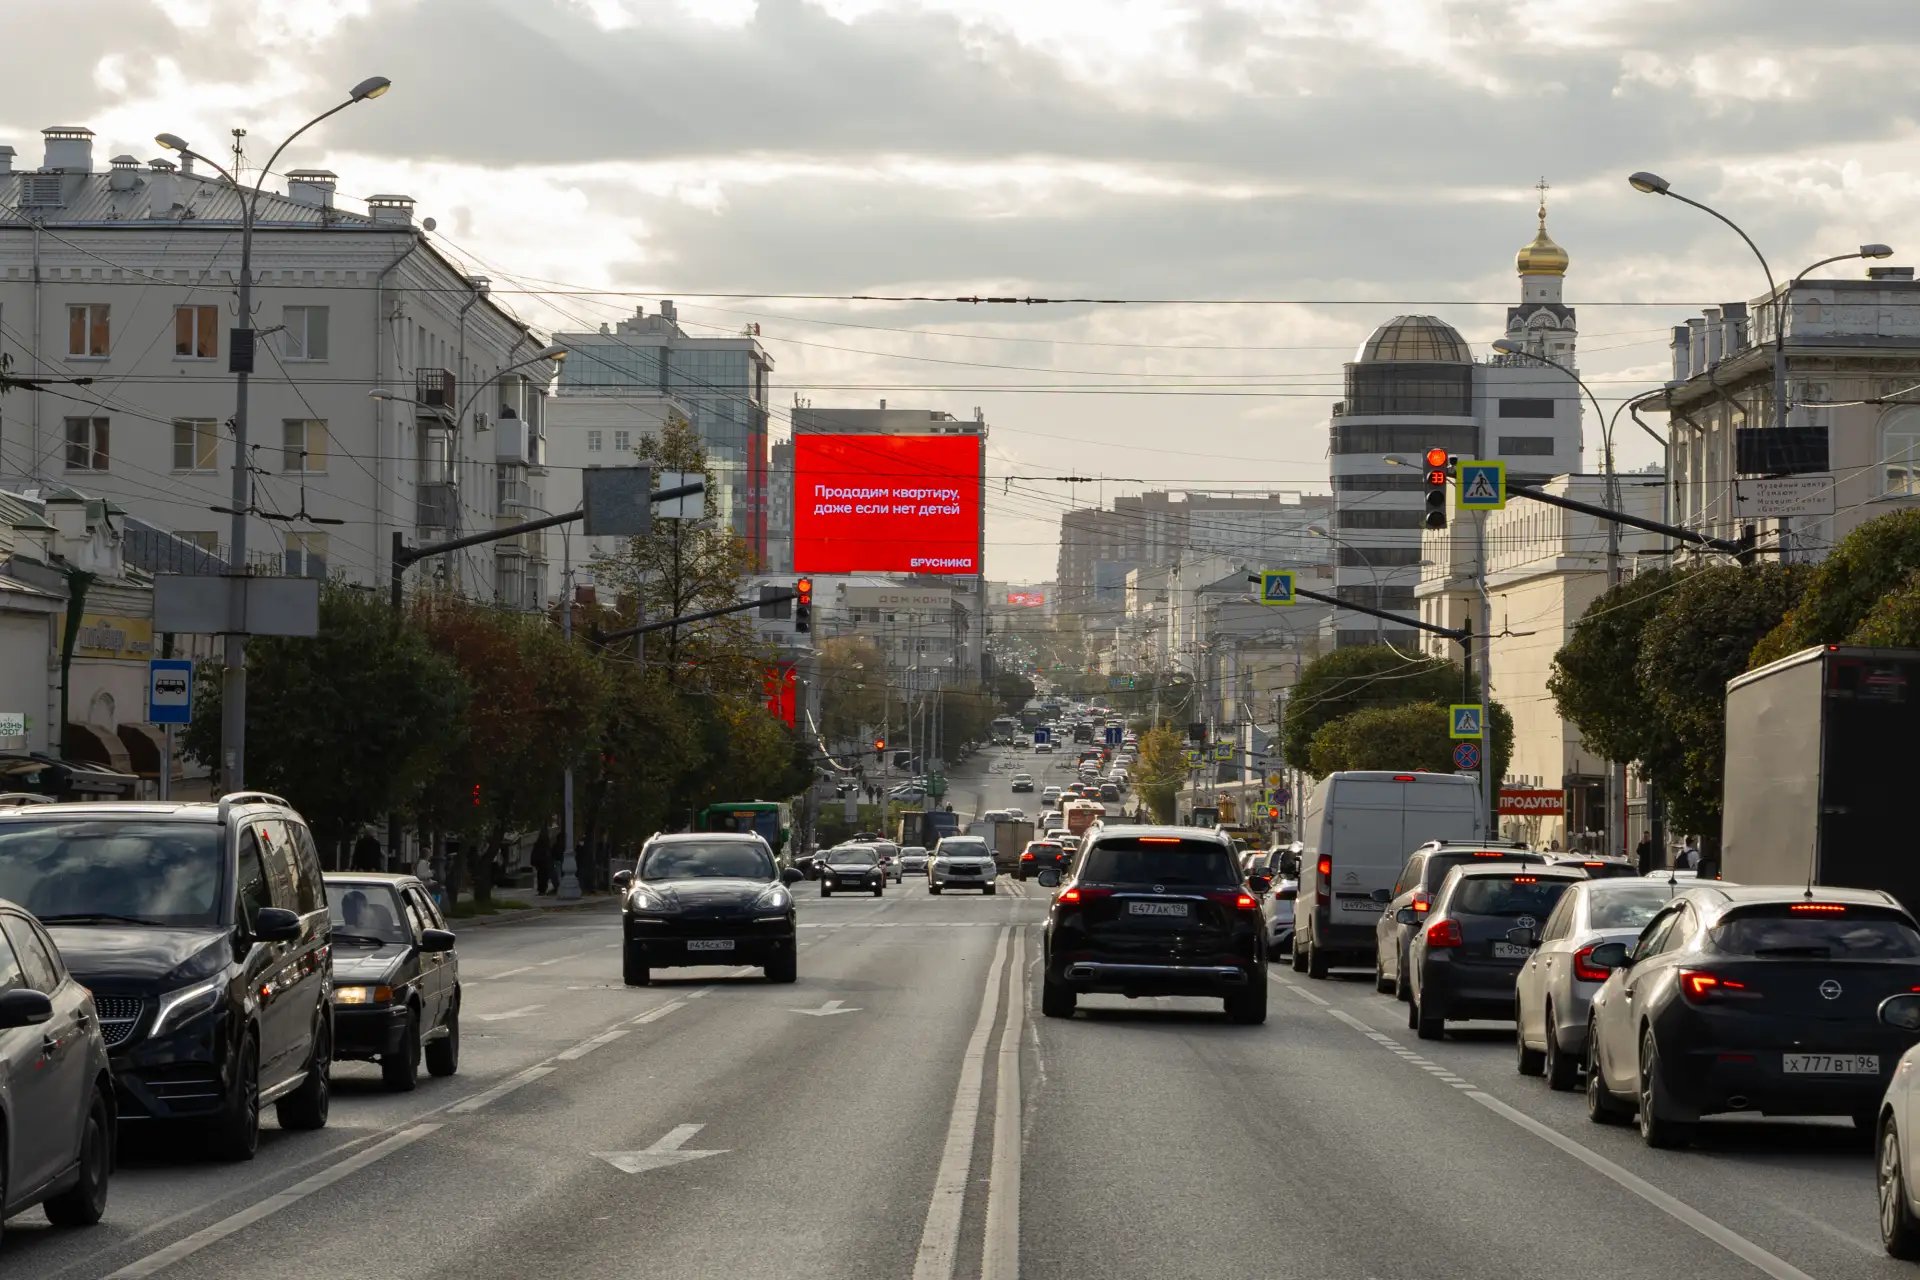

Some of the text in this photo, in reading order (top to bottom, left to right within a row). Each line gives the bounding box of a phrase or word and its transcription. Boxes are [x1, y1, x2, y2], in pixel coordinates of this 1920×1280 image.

[1431, 472, 1444, 484] 33
[1757, 482, 1798, 490] Музейный
[814, 485, 961, 501] Продадим квартиру,
[813, 502, 961, 517] даже если нет детей
[879, 595, 909, 604] ДОМ
[0, 728, 20, 737] арт
[1499, 796, 1563, 809] ПРОДУКТЫ
